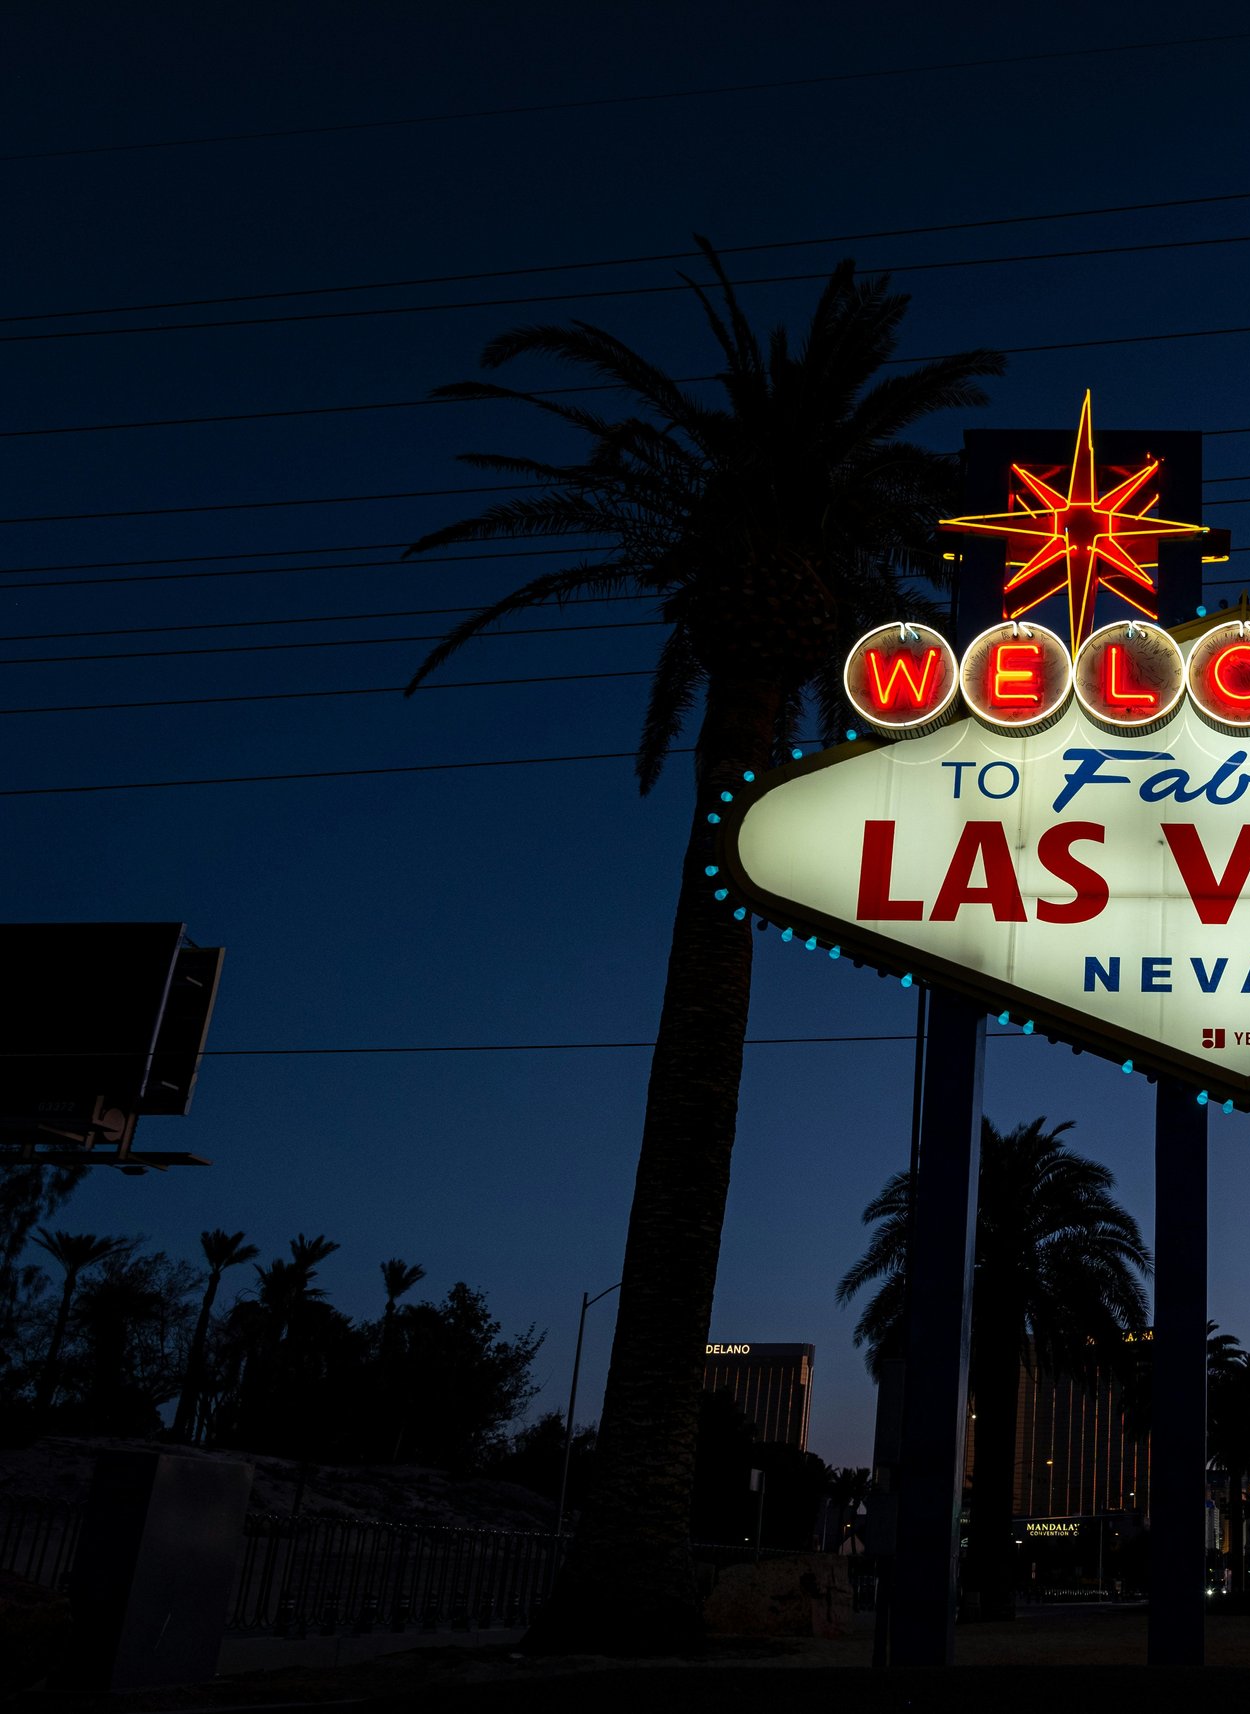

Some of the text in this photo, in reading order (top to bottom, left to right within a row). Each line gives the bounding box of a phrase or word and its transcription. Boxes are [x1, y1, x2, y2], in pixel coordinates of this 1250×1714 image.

[943, 761, 1020, 799] TO
[857, 819, 1110, 925] LAS
[705, 1344, 750, 1355] DELANO
